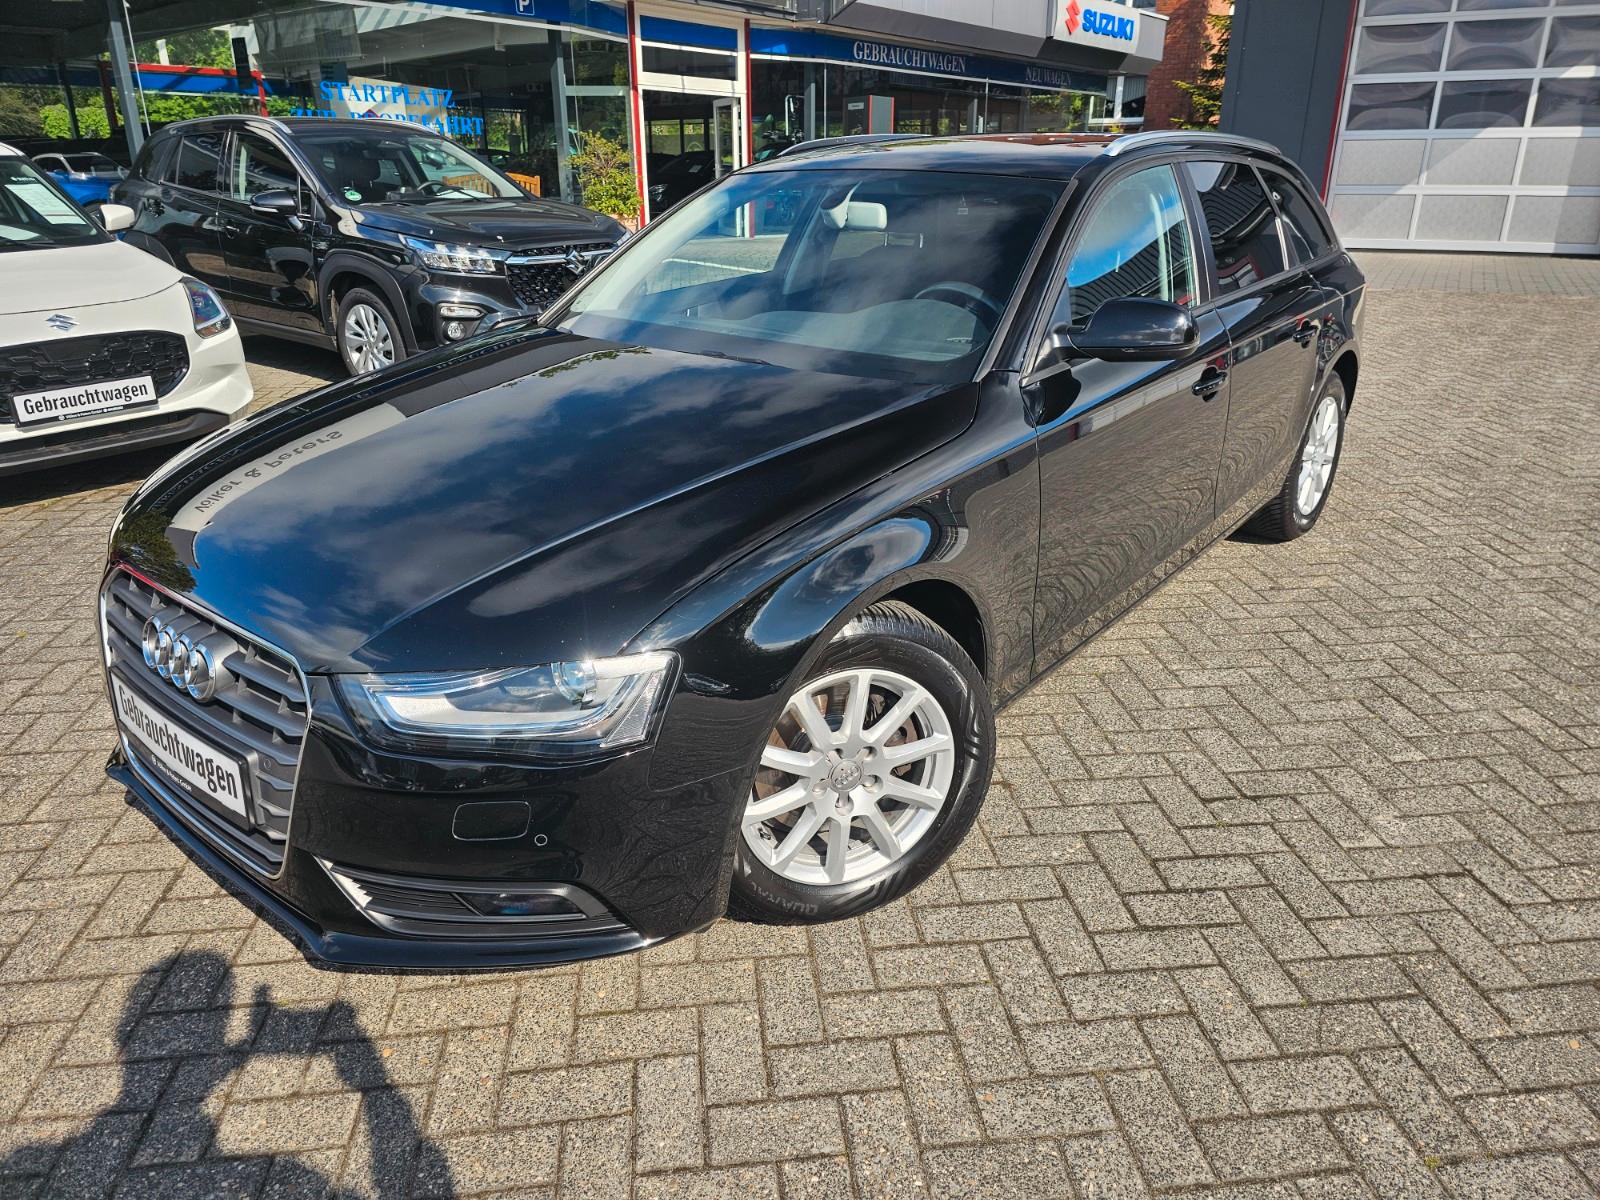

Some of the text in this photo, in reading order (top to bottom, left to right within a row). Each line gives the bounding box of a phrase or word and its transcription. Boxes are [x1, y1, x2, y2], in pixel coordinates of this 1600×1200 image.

[518, 0, 530, 12] P
[1082, 8, 1135, 41] SUZUKI
[853, 41, 966, 73] GEBRAUCHTWAGEN
[1025, 65, 1072, 86] NEUWAGEN
[319, 80, 456, 108] STARTPLATZ
[23, 383, 149, 415] Gebrauchtwagen
[118, 684, 239, 800] Gebrauchtwagen
